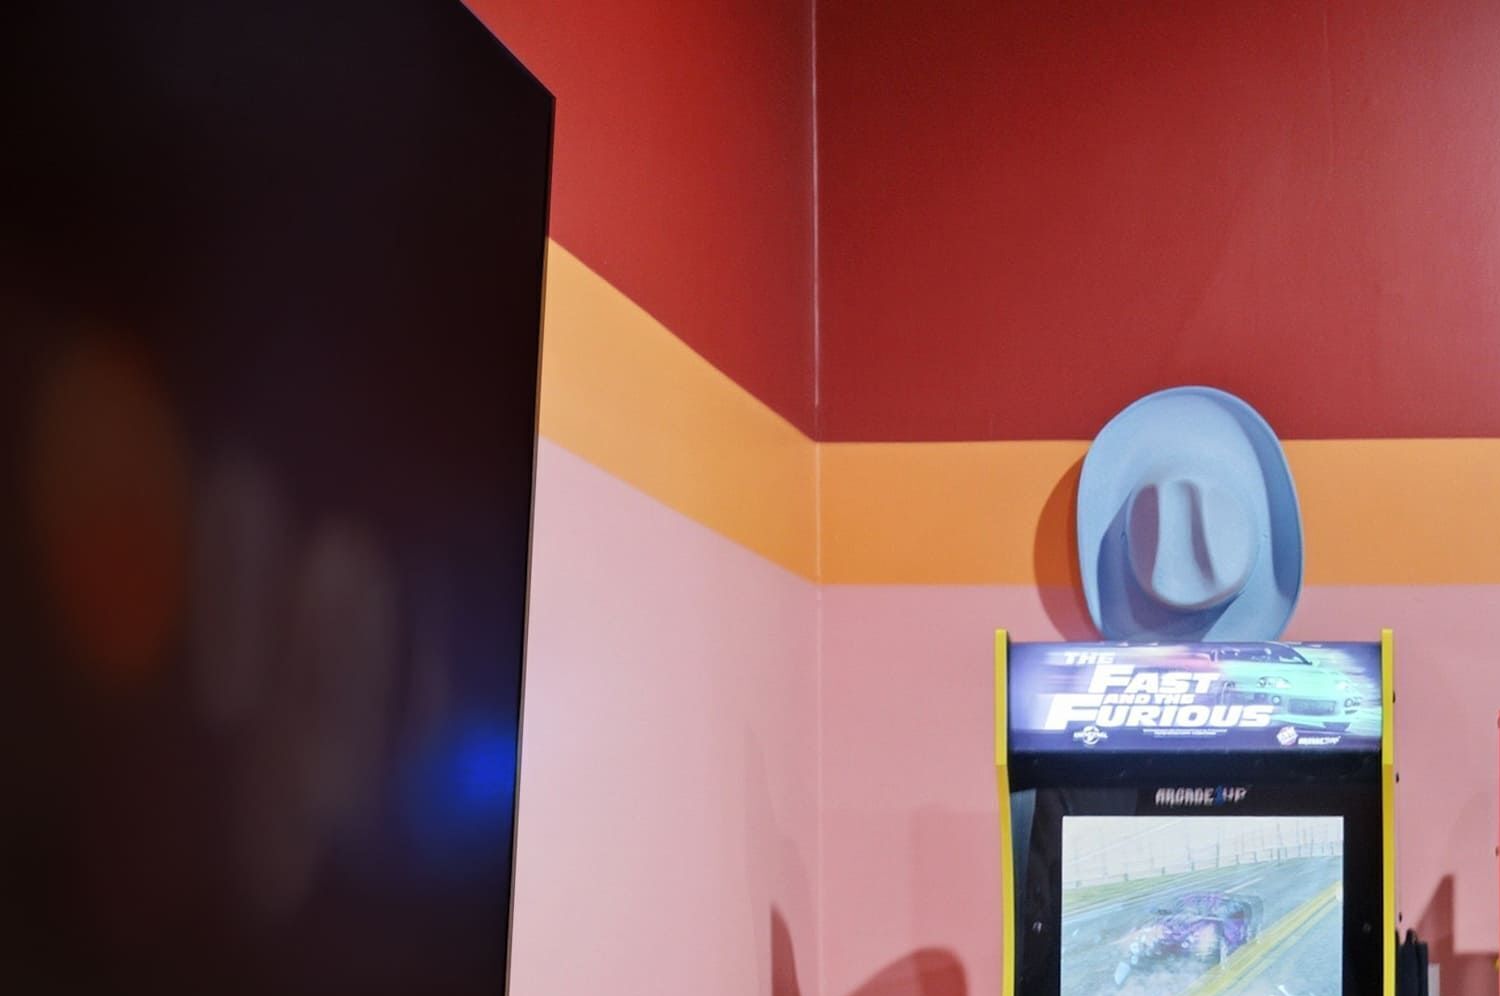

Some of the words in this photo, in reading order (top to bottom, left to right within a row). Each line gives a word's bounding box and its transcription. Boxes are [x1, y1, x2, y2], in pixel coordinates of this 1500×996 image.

[1063, 652, 1116, 665] THE
[1088, 664, 1221, 693] FAST
[1103, 694, 1150, 705] AND
[1154, 694, 1196, 705] THE
[1044, 694, 1274, 730] FURIOUS
